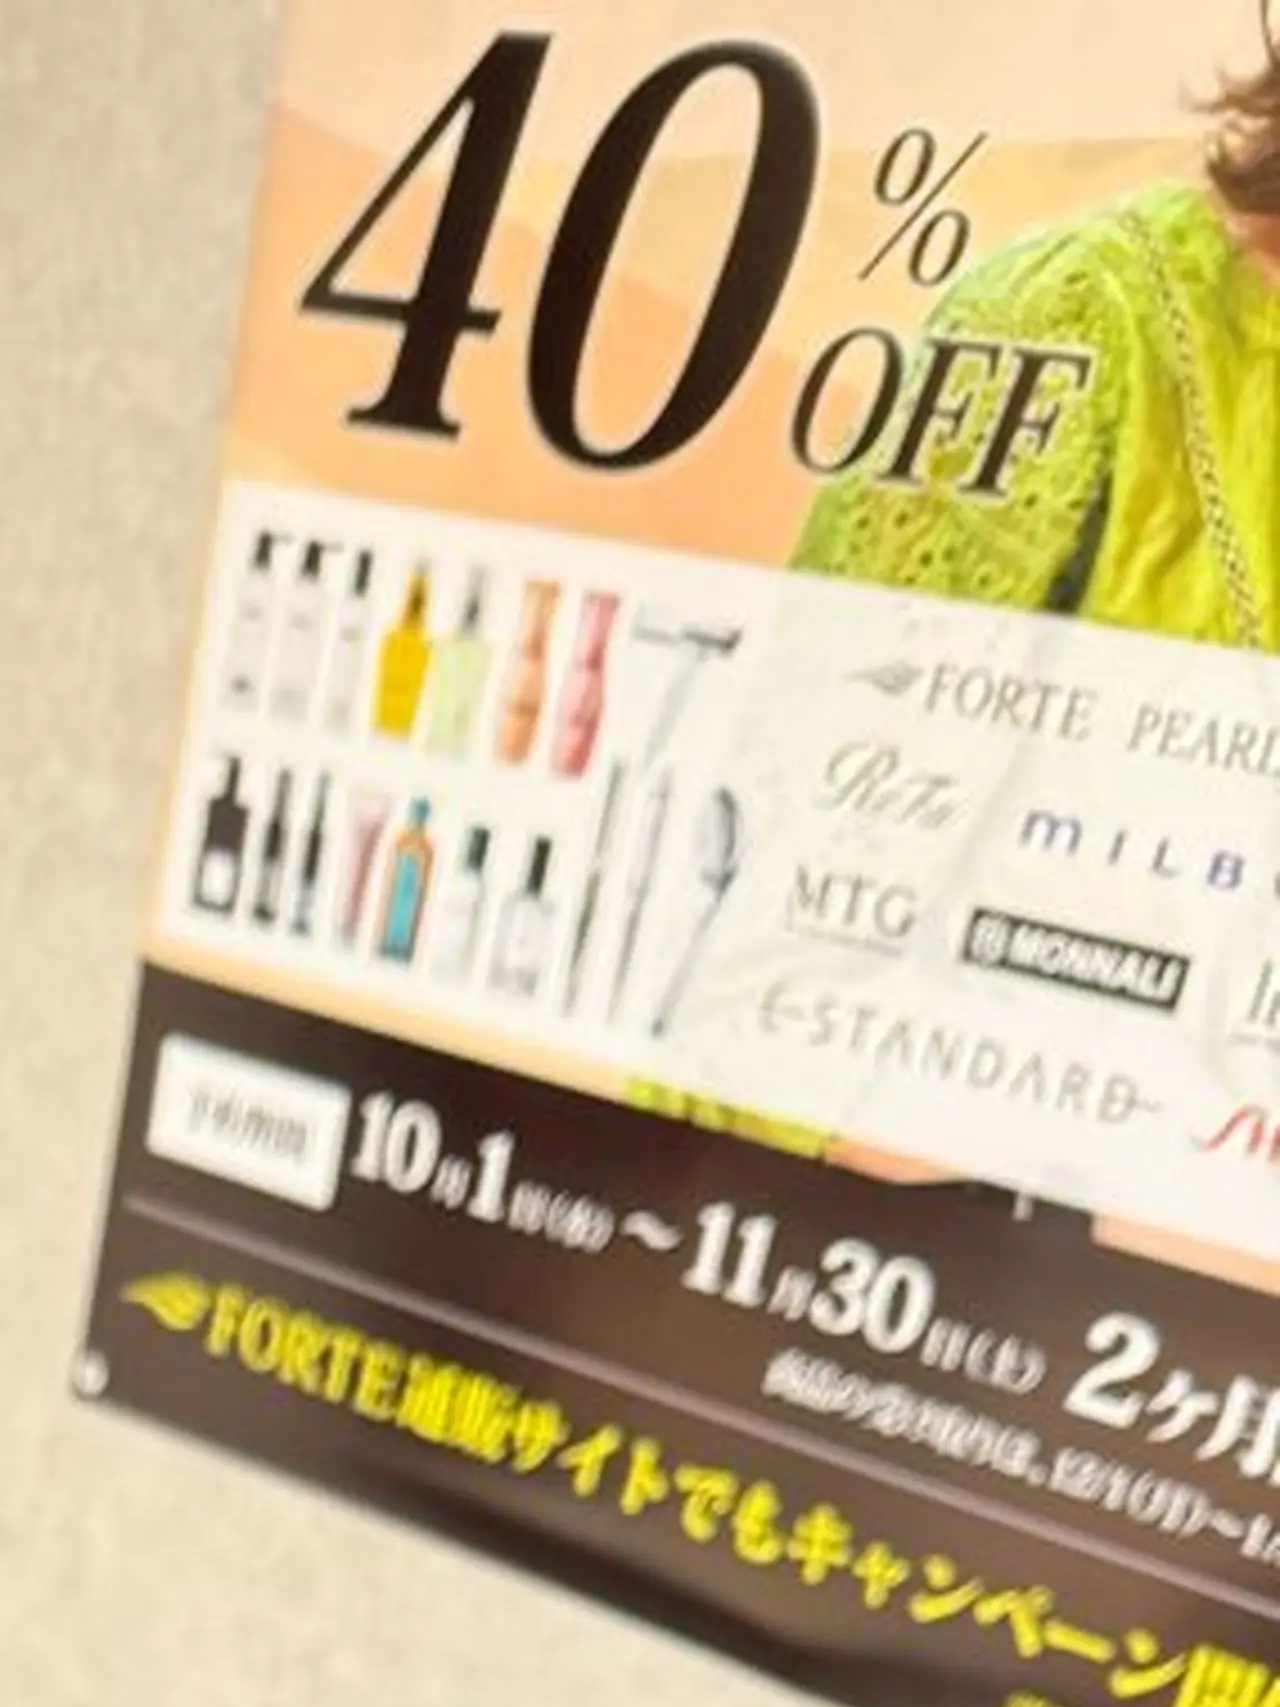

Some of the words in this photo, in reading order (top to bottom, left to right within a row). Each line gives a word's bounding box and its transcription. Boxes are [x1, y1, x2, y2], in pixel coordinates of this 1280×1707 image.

[300, 30, 823, 472] 40
[790, 325, 1092, 498] OFF
[922, 660, 1100, 744] FORTE
[1062, 1310, 1280, 1488] 2ヶ月
